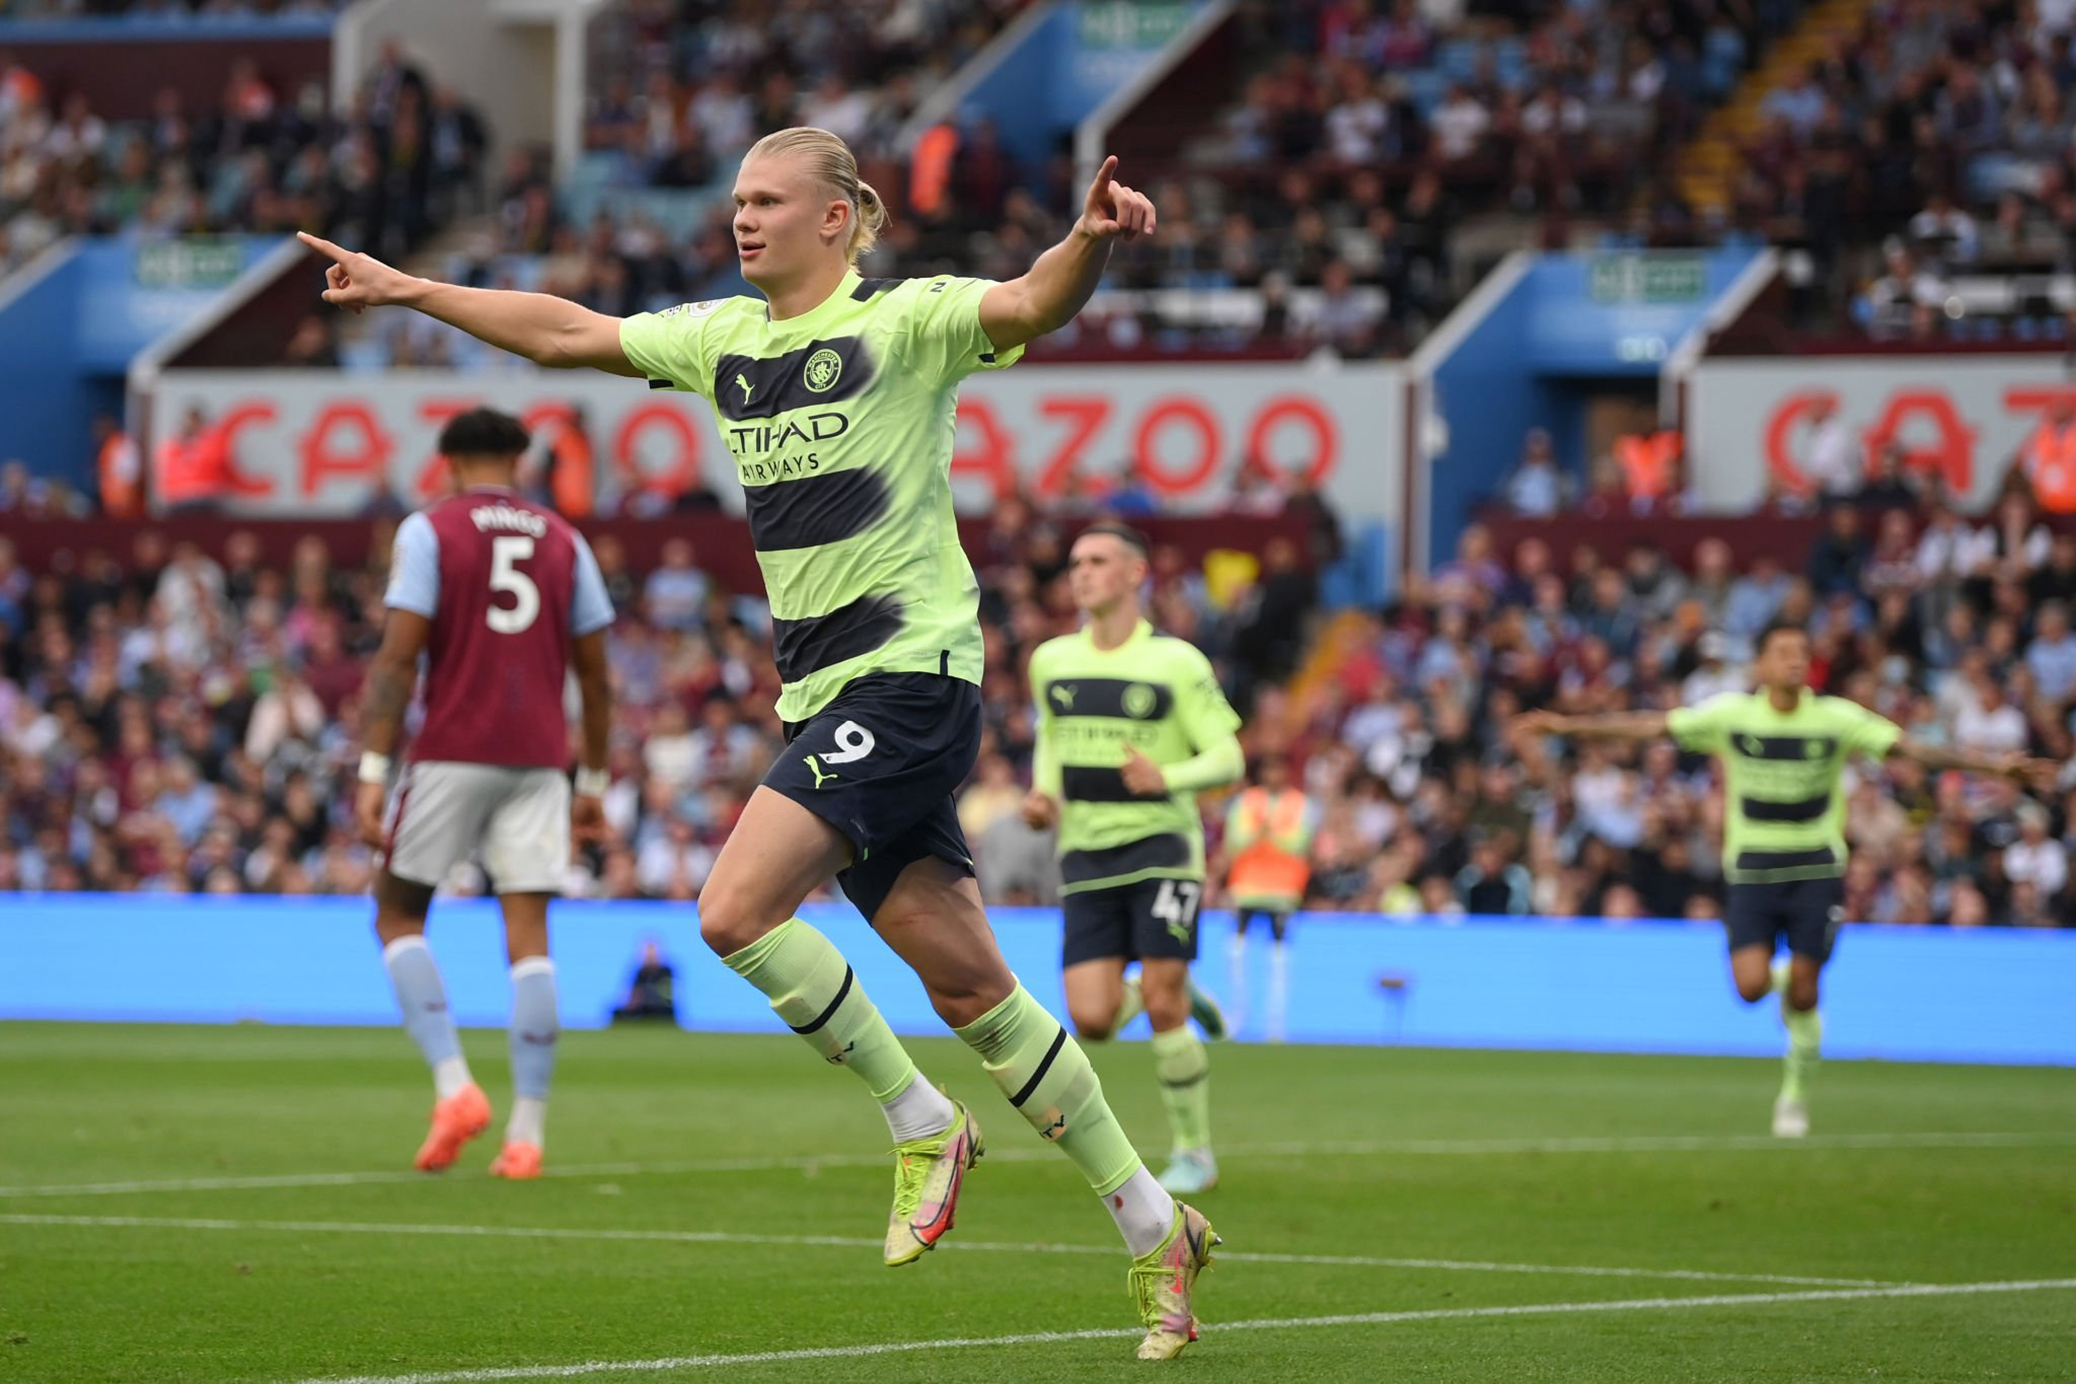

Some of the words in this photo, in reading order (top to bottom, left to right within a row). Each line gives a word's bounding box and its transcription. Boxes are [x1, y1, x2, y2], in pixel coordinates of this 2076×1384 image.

[729, 412, 849, 454] TIHAD
[951, 394, 1340, 496] AZOO
[741, 452, 819, 480] AIRWAYS
[470, 506, 547, 539] MINGS
[485, 535, 541, 635] 5
[818, 720, 875, 765] 9
[1150, 879, 1200, 928] 47
